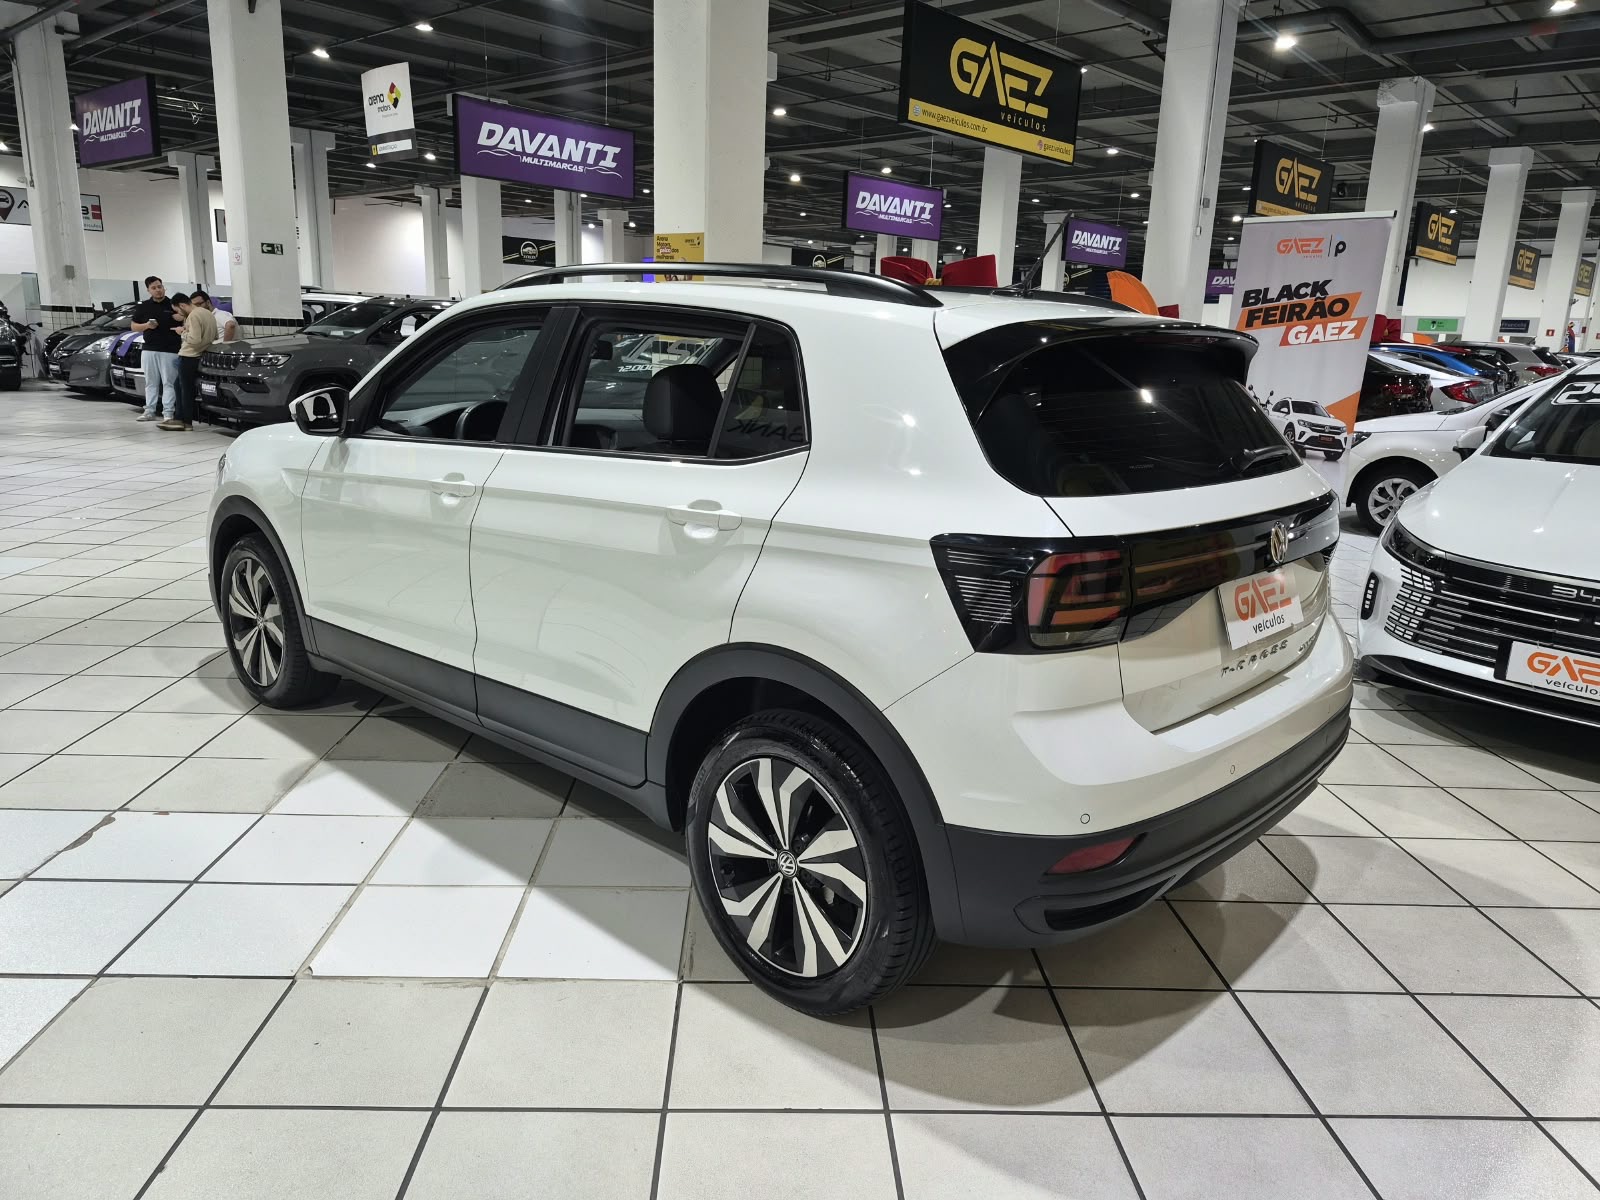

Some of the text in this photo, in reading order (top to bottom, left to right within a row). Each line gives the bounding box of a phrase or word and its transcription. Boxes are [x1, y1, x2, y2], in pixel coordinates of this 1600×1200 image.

[949, 37, 1054, 119] GAEZ
[368, 93, 385, 106] arena
[83, 98, 142, 136] DAVANTI
[477, 121, 622, 168] DAVANTI
[521, 155, 584, 173] MULTIMARCAS
[1275, 157, 1322, 203] GAEZ
[855, 190, 935, 220] DAVANTI
[1071, 229, 1123, 251] DAVANTI
[1427, 212, 1456, 246] GAEZ
[1276, 236, 1325, 255] GAEZ
[1241, 279, 1334, 308] BLACK
[1245, 295, 1350, 328] FEIRÃO
[1287, 320, 1358, 345] GAEZ
[1234, 571, 1293, 622] GAEZ
[1545, 678, 1600, 697] veículo
